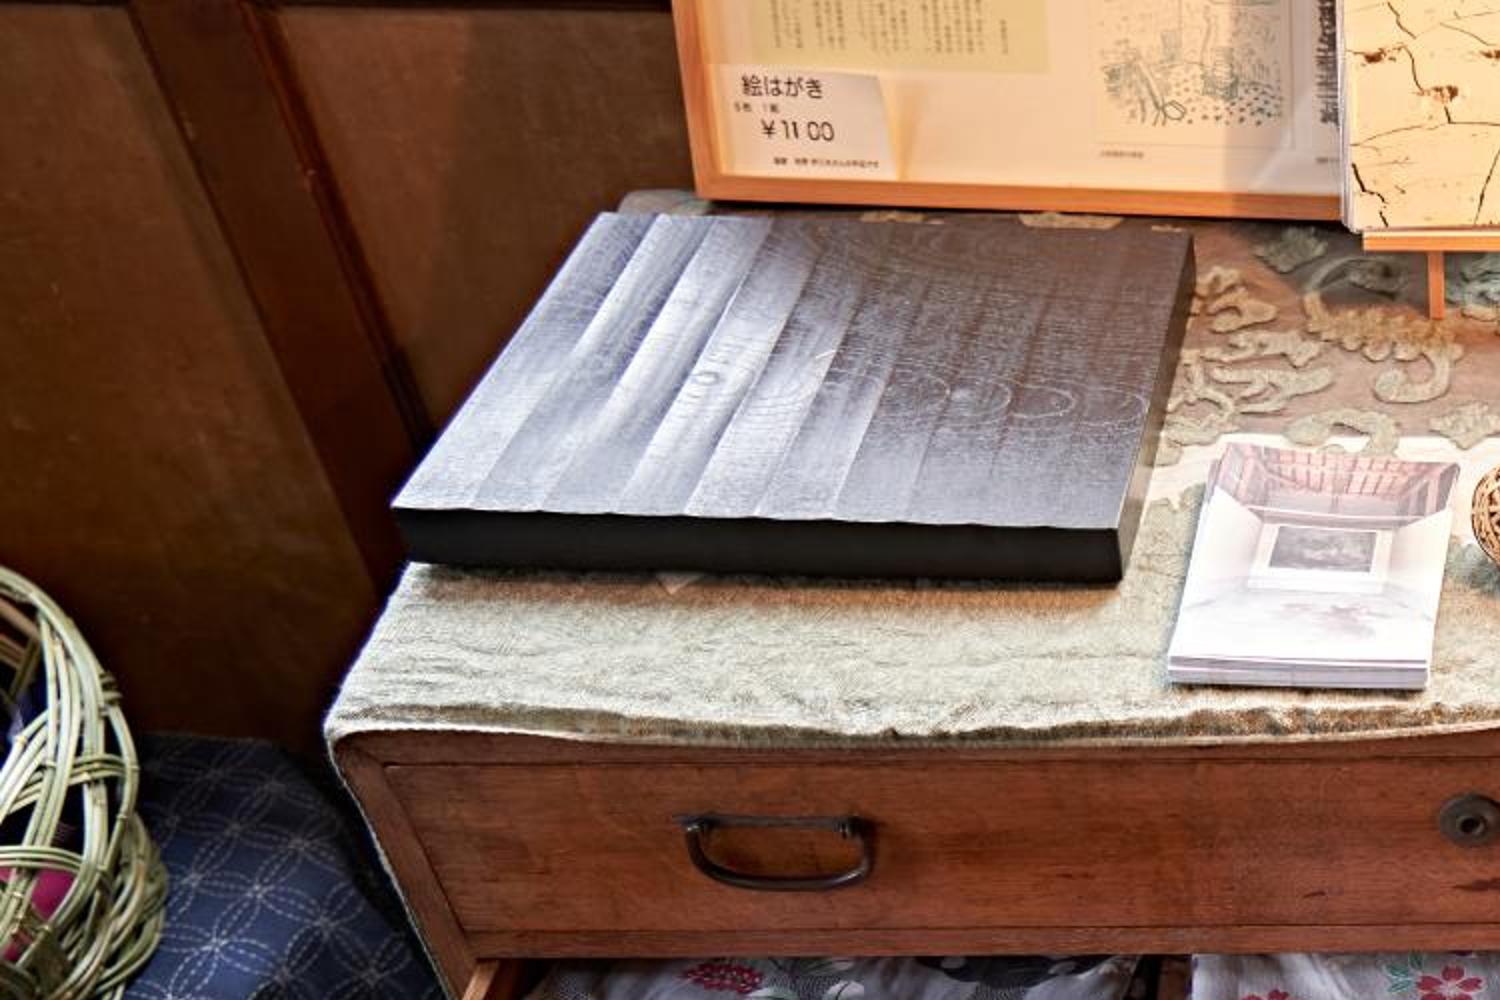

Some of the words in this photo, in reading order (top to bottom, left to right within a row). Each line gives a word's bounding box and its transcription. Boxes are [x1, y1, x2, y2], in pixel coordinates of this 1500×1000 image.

[741, 74, 824, 99] 絵はがき
[760, 118, 835, 142] ¥1100
